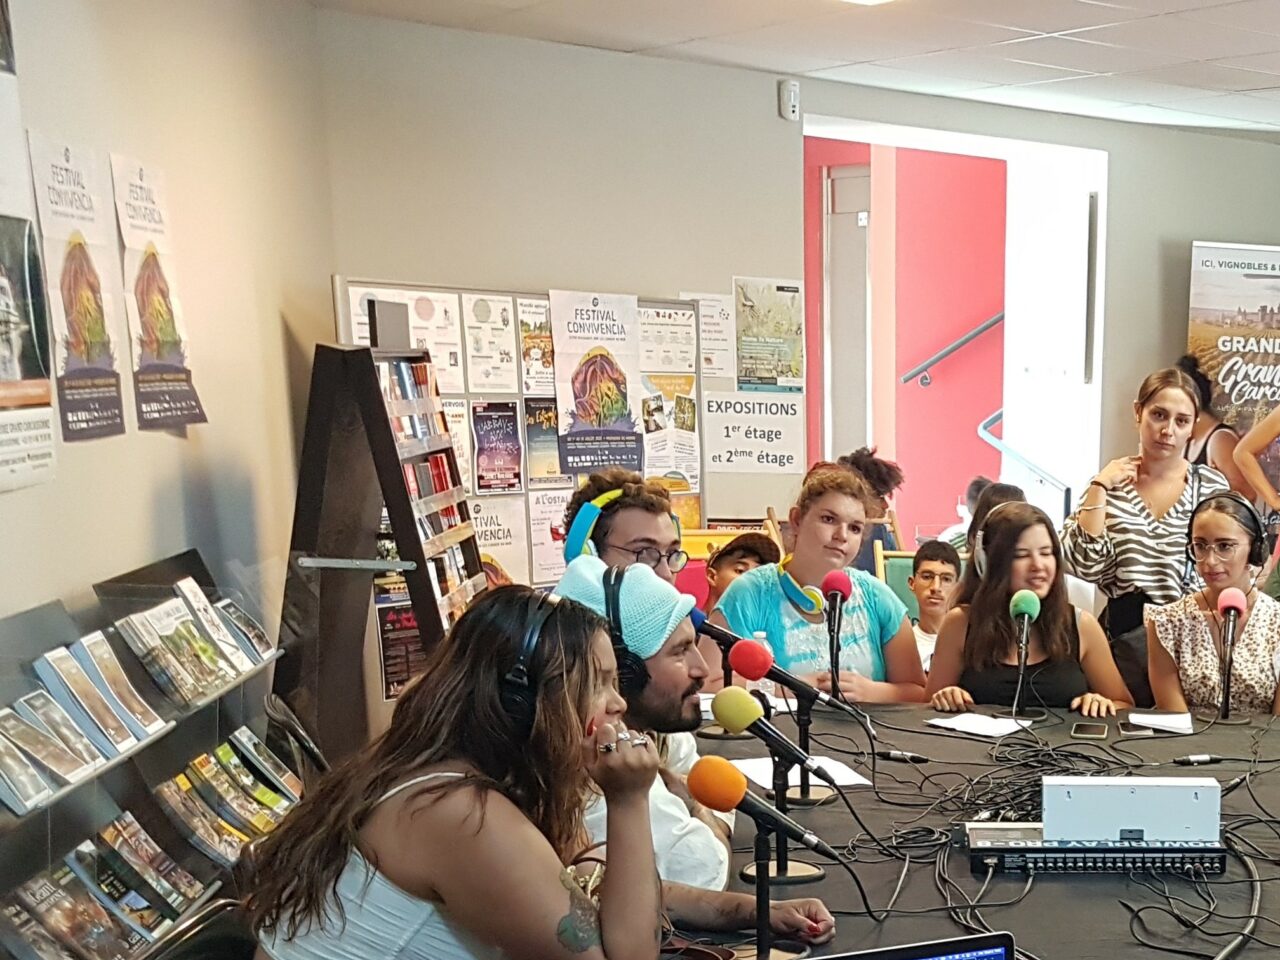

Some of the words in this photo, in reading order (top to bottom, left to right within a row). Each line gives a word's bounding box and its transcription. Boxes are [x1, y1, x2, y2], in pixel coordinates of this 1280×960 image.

[1218, 260, 1268, 271] VIGNOBLES
[1270, 263, 1277, 271] &
[574, 308, 617, 322] FESTIVAL
[567, 321, 626, 336] CONVIVENCIA
[707, 400, 797, 416] EXPOSITIONS
[744, 425, 782, 443] étage
[711, 453, 722, 463] et
[725, 448, 753, 463] 2ème
[756, 450, 794, 467] étage
